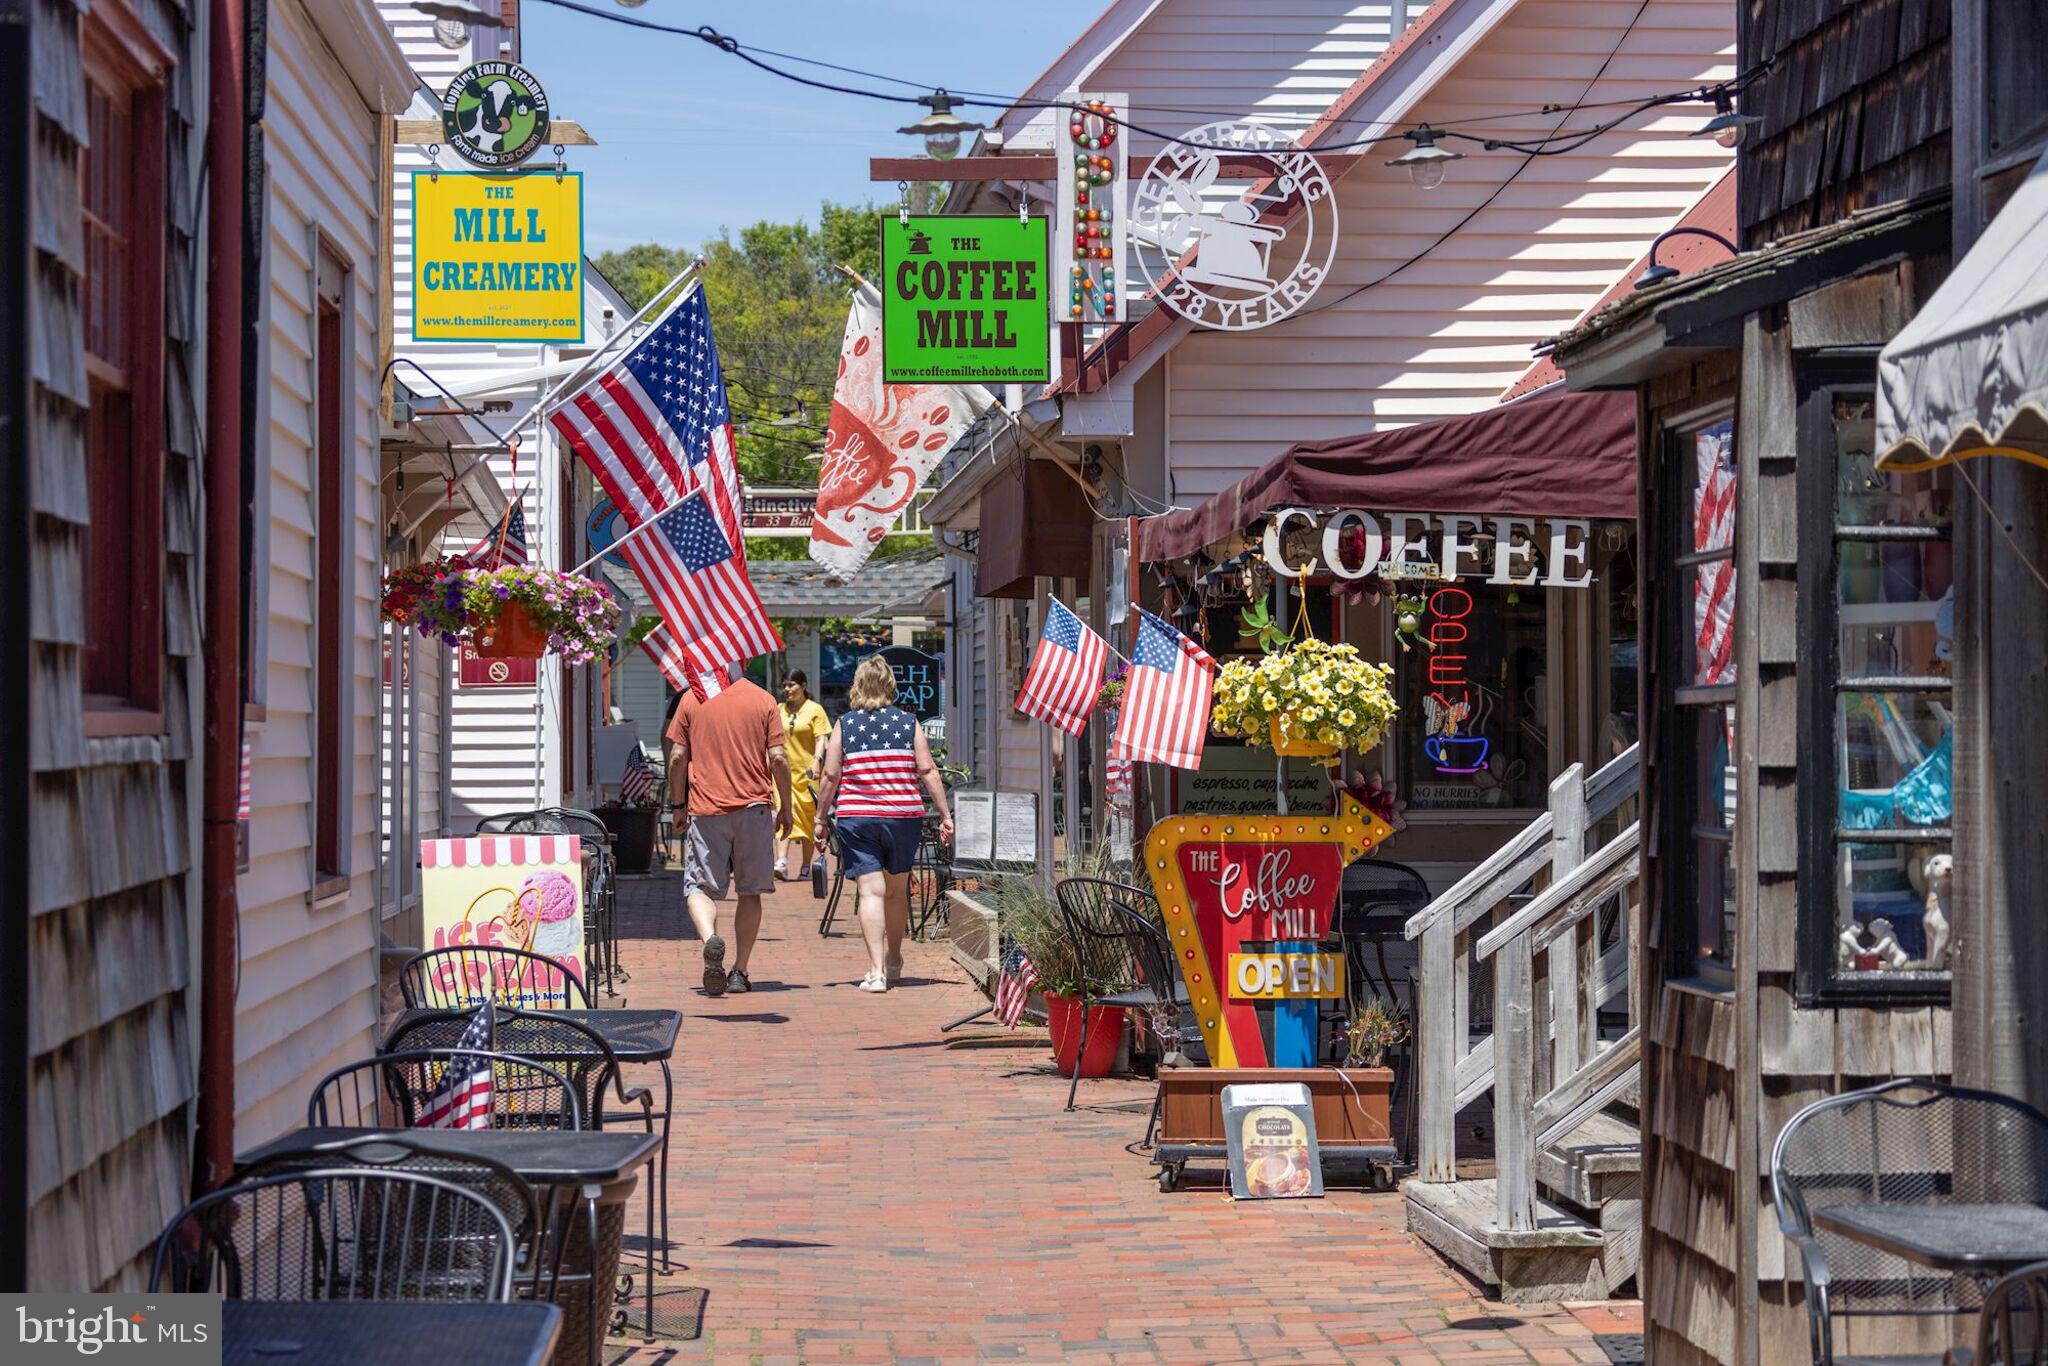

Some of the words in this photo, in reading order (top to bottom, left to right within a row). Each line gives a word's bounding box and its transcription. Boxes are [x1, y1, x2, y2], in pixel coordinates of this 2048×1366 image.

[443, 69, 476, 112] Hopkins
[475, 63, 507, 77] Farm
[509, 65, 547, 112] Creamery
[471, 150, 498, 164] made
[500, 152, 514, 163] ice
[515, 134, 540, 158] cream
[485, 186, 514, 199] THE
[1069, 99, 1119, 318] OPEN
[454, 208, 546, 243] MILL
[950, 237, 981, 251] THE
[423, 261, 577, 292] CREAMERY
[896, 260, 1036, 301] COFFEE
[1170, 283, 1207, 319] 28
[1218, 263, 1323, 327] YEARS
[422, 315, 577, 329] www.themillcreamery.com
[917, 310, 1017, 348] MILL
[891, 365, 1044, 377] www.coffeemillrehoboth.com
[766, 516, 781, 527] 33
[1262, 507, 1594, 588] COFFEE
[1192, 776, 1250, 791] espresso,
[1414, 786, 1431, 798] NO
[1434, 786, 1479, 799] HURRIES
[1190, 850, 1219, 872] THE
[1209, 848, 1316, 919] Coffee
[434, 921, 504, 951] ICE
[1271, 907, 1320, 939] MILL
[432, 955, 584, 993] CREAM
[1238, 957, 1336, 994] OPEN
